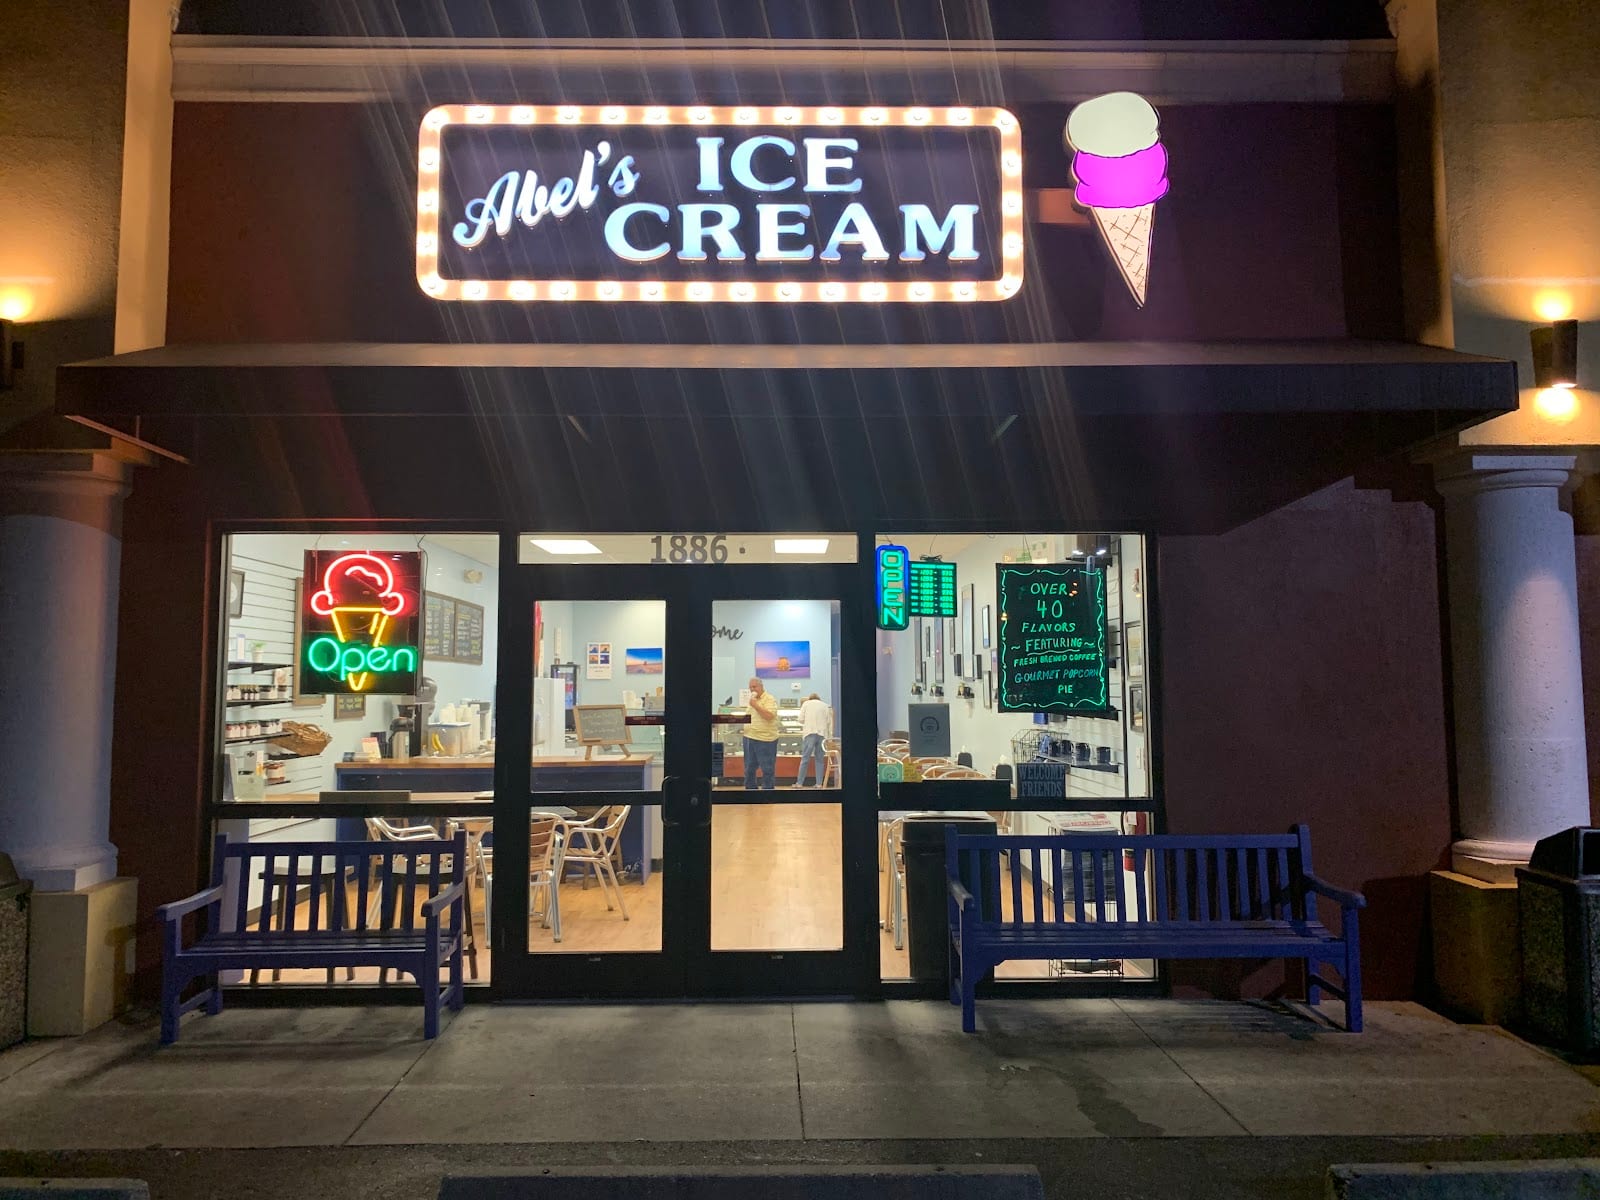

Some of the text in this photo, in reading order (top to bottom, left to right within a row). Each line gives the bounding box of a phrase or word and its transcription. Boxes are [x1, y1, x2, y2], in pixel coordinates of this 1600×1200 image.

[696, 135, 862, 192] ICE
[453, 141, 640, 248] Abel's
[604, 202, 980, 261] CREAM
[651, 535, 728, 564] 1886
[882, 550, 904, 626] OPEN
[1030, 583, 1068, 595] OVER
[1037, 599, 1063, 618] 40
[1021, 622, 1076, 633] FLAVORS
[1025, 637, 1083, 652] FEATURING
[308, 637, 414, 681] Open
[1013, 653, 1097, 667] FRESH BREWED COFFEE
[1014, 668, 1099, 683] GOURMET POPCORN
[1057, 684, 1073, 694] PIE
[1018, 764, 1065, 780] WELCOME
[1020, 781, 1063, 797] FRIENDS
